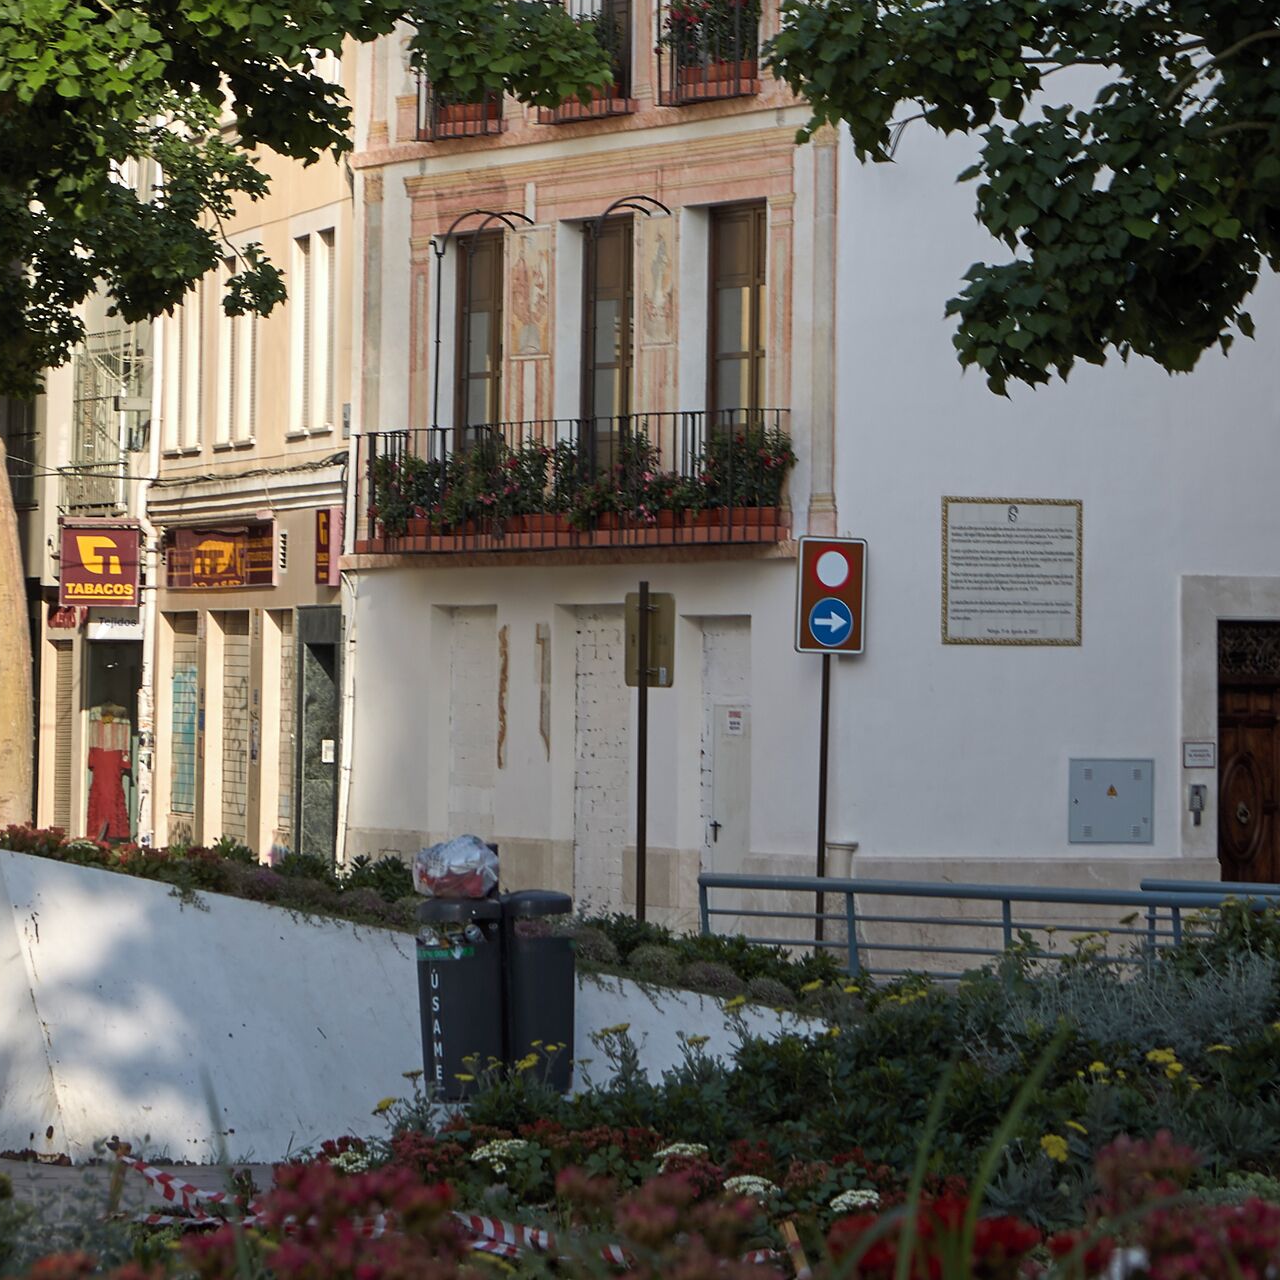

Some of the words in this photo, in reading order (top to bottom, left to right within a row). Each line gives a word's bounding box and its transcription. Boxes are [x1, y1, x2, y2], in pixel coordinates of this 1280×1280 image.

[65, 583, 133, 595] TABACOS
[99, 617, 137, 628] Tejidos
[430, 968, 443, 1080] ÚSAME
